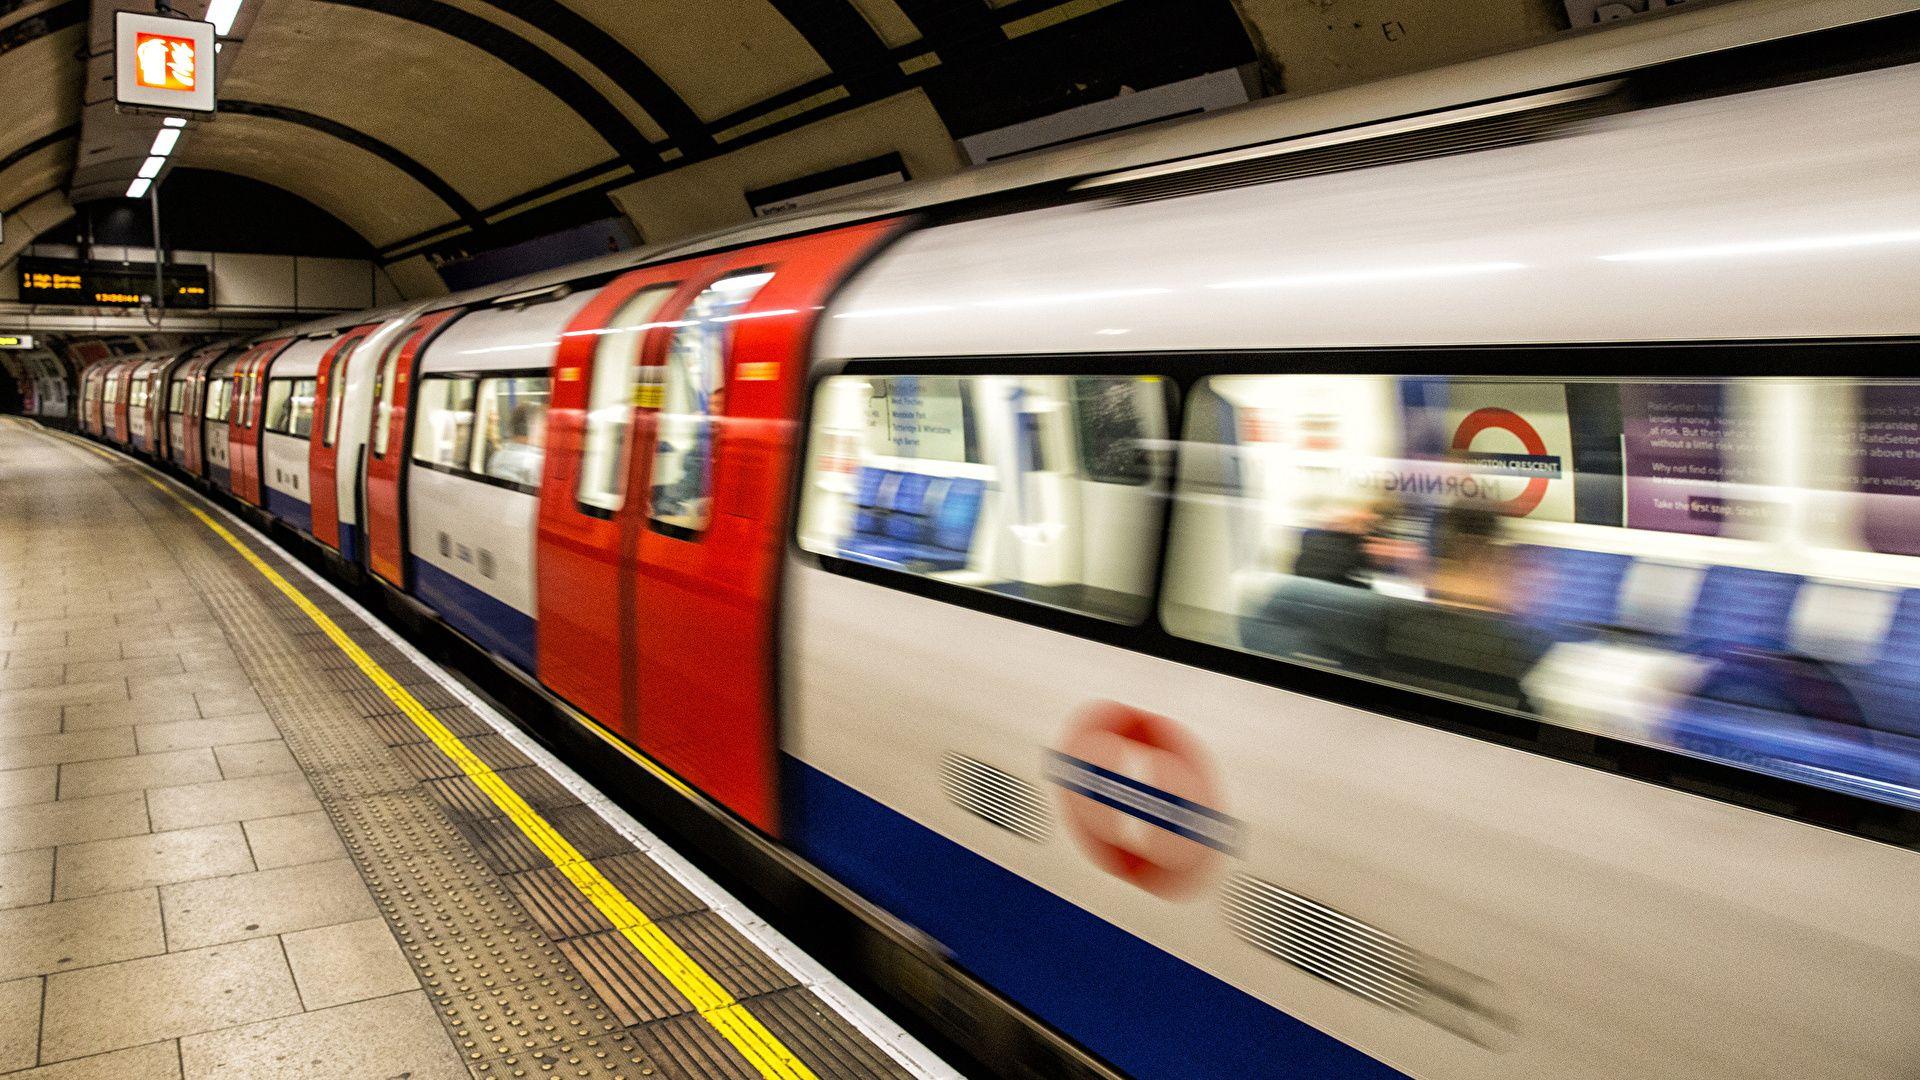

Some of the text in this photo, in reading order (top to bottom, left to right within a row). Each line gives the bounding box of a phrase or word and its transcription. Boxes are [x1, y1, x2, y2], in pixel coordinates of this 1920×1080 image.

[1508, 460, 1558, 472] CRESCENT
[1651, 462, 1672, 475] Why
[1673, 464, 1688, 475] not
[1653, 498, 1673, 510] Take
[1675, 500, 1690, 511] the
